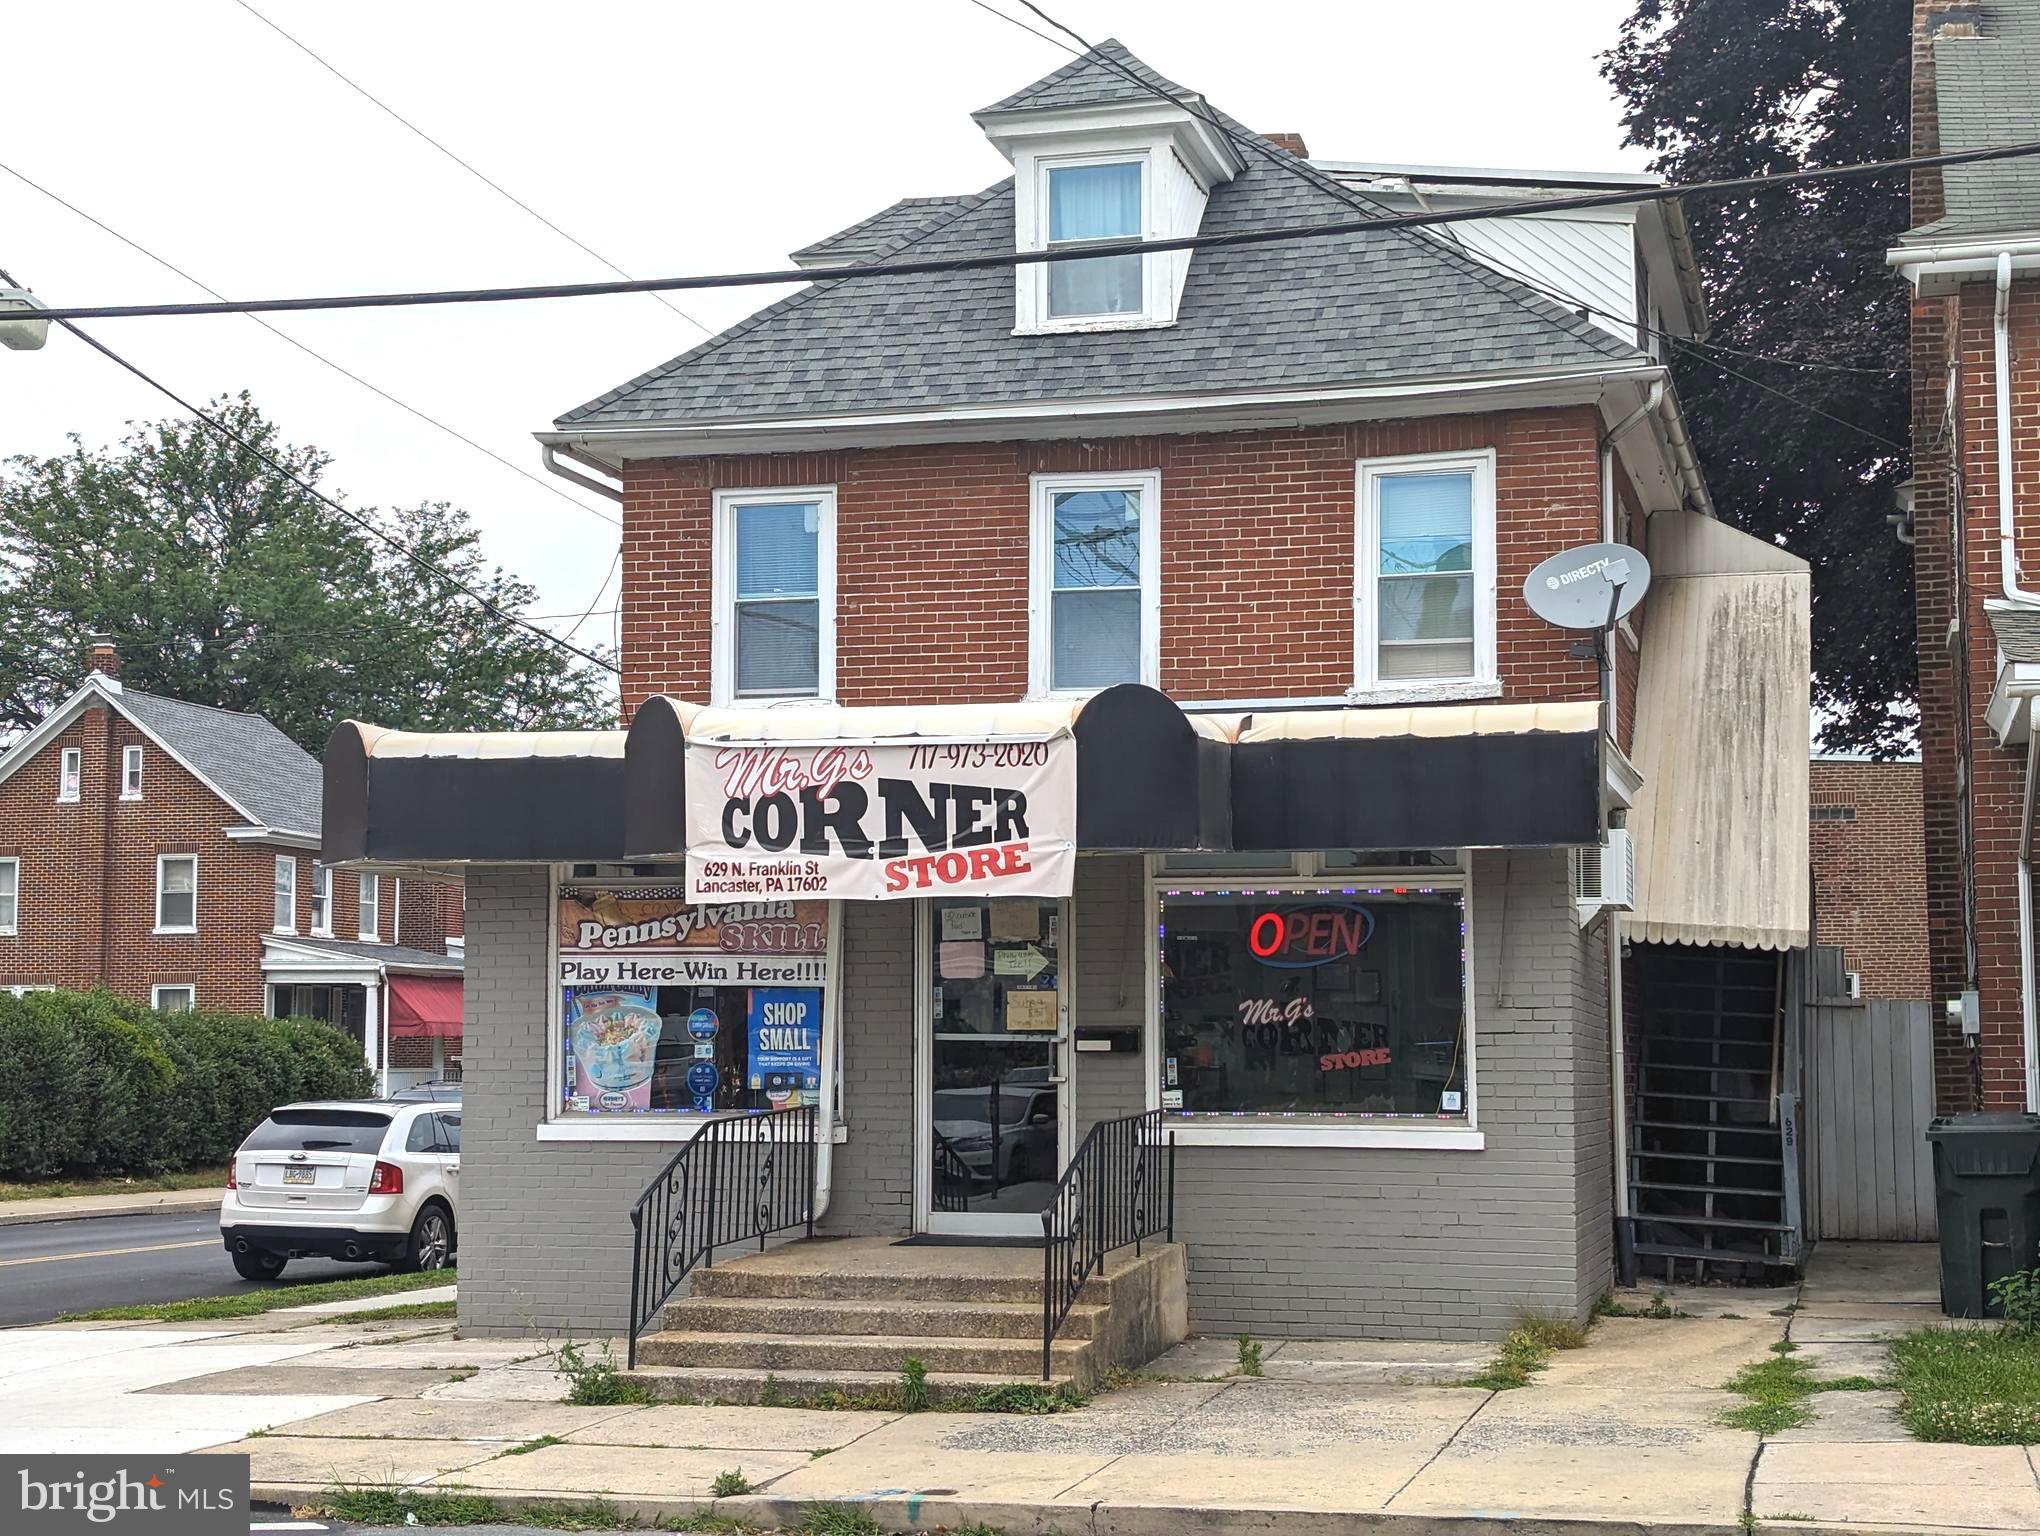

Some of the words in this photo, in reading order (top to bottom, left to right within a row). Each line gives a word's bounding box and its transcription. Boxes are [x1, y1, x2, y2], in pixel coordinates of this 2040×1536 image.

[1560, 558, 1609, 585] DIRECTV
[908, 742, 1050, 770] 717-973-2020
[722, 778, 1030, 860] CORNER
[703, 862, 728, 877] 629
[731, 862, 746, 876] N.
[749, 860, 801, 876] Franklin
[804, 860, 820, 876] St
[886, 843, 1032, 892] STORE
[695, 878, 763, 895] Lancaster,
[765, 877, 784, 892] PA
[786, 876, 828, 892] 17602
[576, 900, 796, 949] Pennsylvania
[719, 922, 826, 952] SKILL
[1250, 912, 1363, 957] OPEN
[560, 962, 610, 984] Play
[617, 962, 728, 981] Here-Win
[764, 1002, 807, 1025] SHOP
[759, 1028, 811, 1051] SMALL
[1242, 1018, 1390, 1055] CORNER
[1320, 1048, 1392, 1072] STORE
[1785, 1117, 1793, 1146] 629
